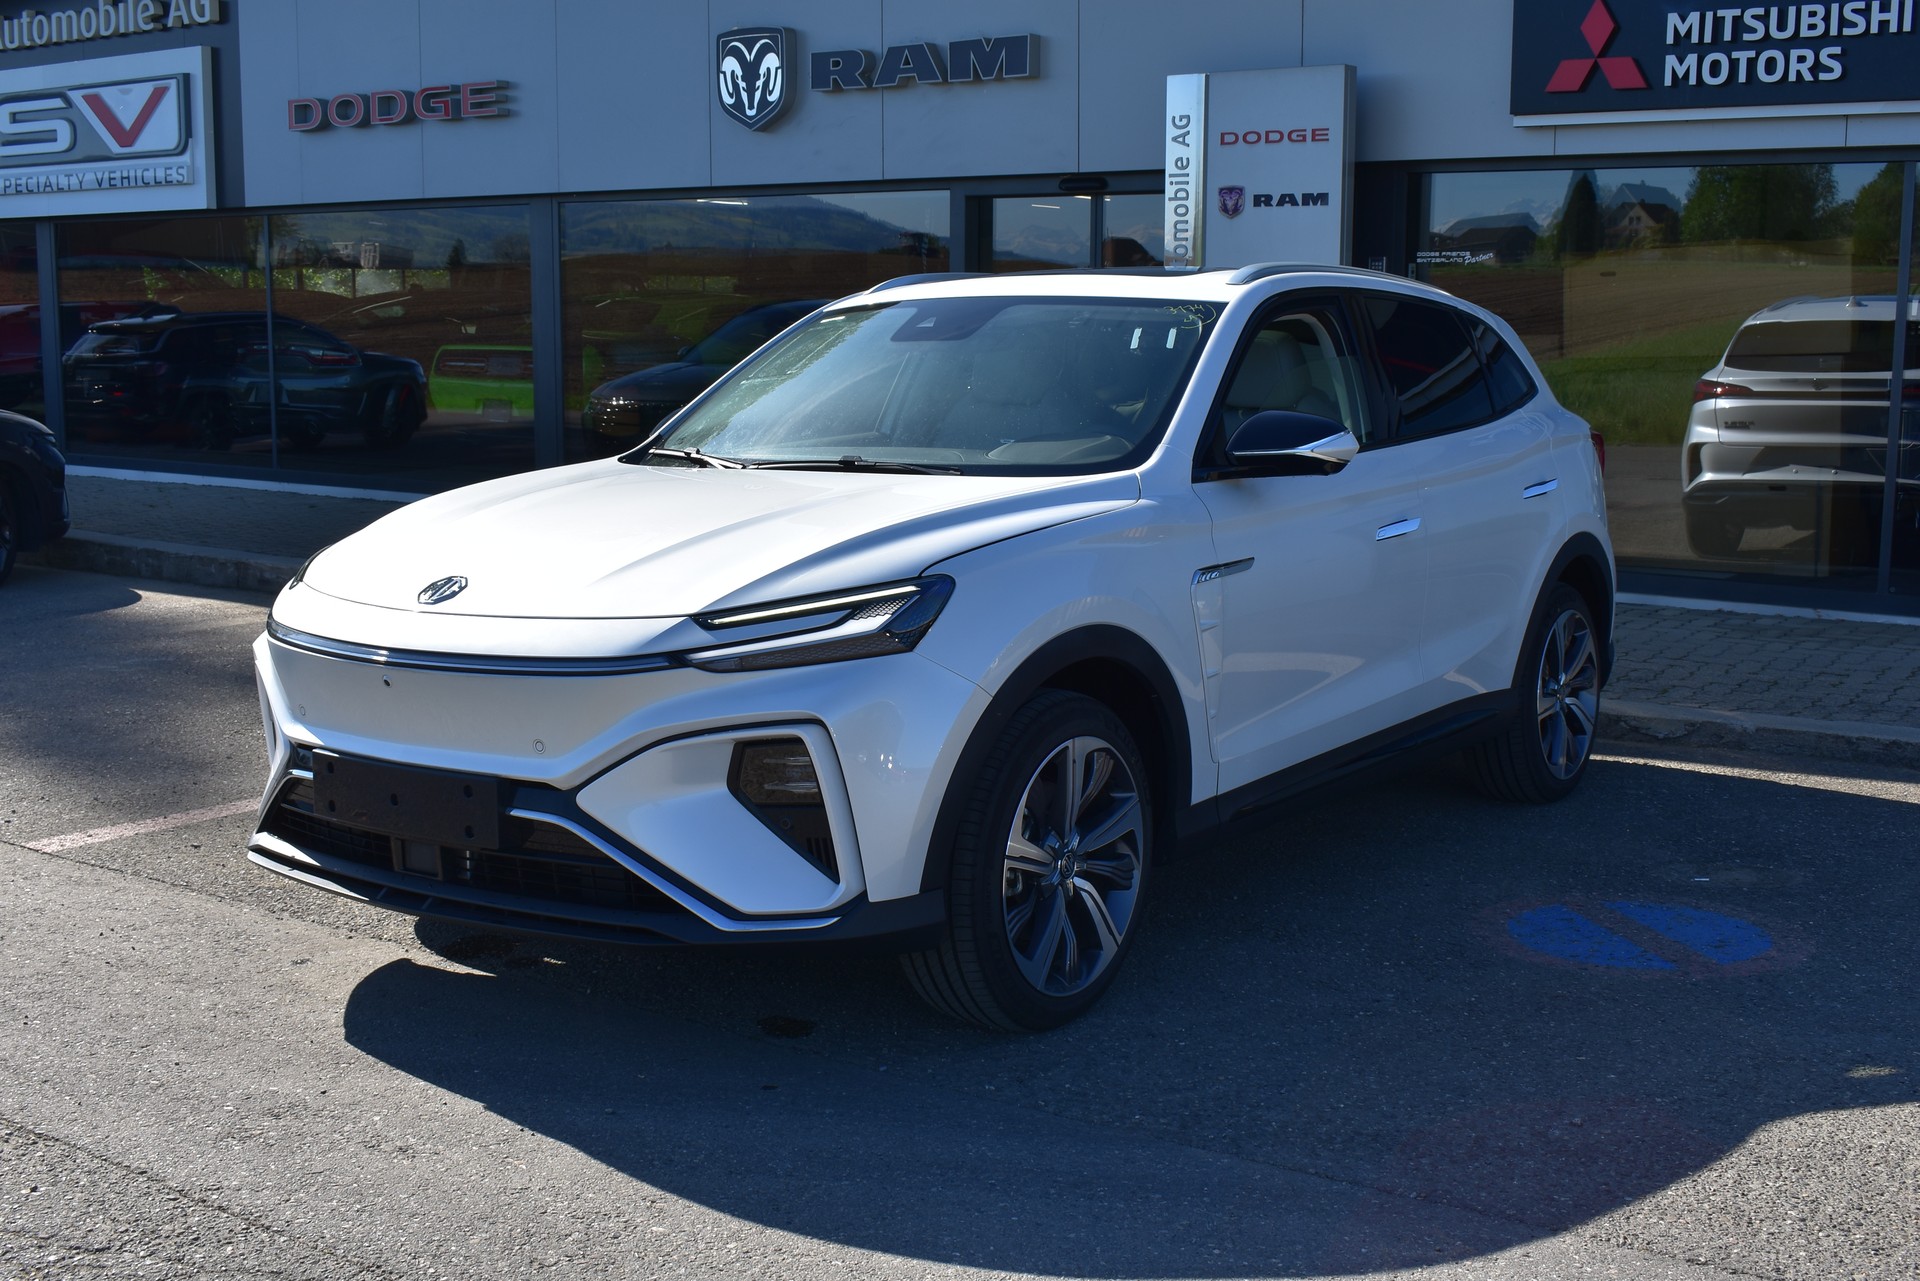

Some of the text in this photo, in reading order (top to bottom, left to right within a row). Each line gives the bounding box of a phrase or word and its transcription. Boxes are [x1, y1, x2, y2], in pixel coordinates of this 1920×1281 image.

[0, 0, 210, 48] utomobile AG
[1666, 0, 1912, 45] MITSUBISHI
[810, 33, 1030, 91] RAM
[1663, 46, 1843, 87] MOTORS
[288, 80, 499, 131] DODGE
[1171, 113, 1191, 148] AG
[1219, 127, 1330, 147] DODGE
[3, 165, 186, 194] PECIALTY VEHICLES
[1252, 192, 1330, 208] RAM
